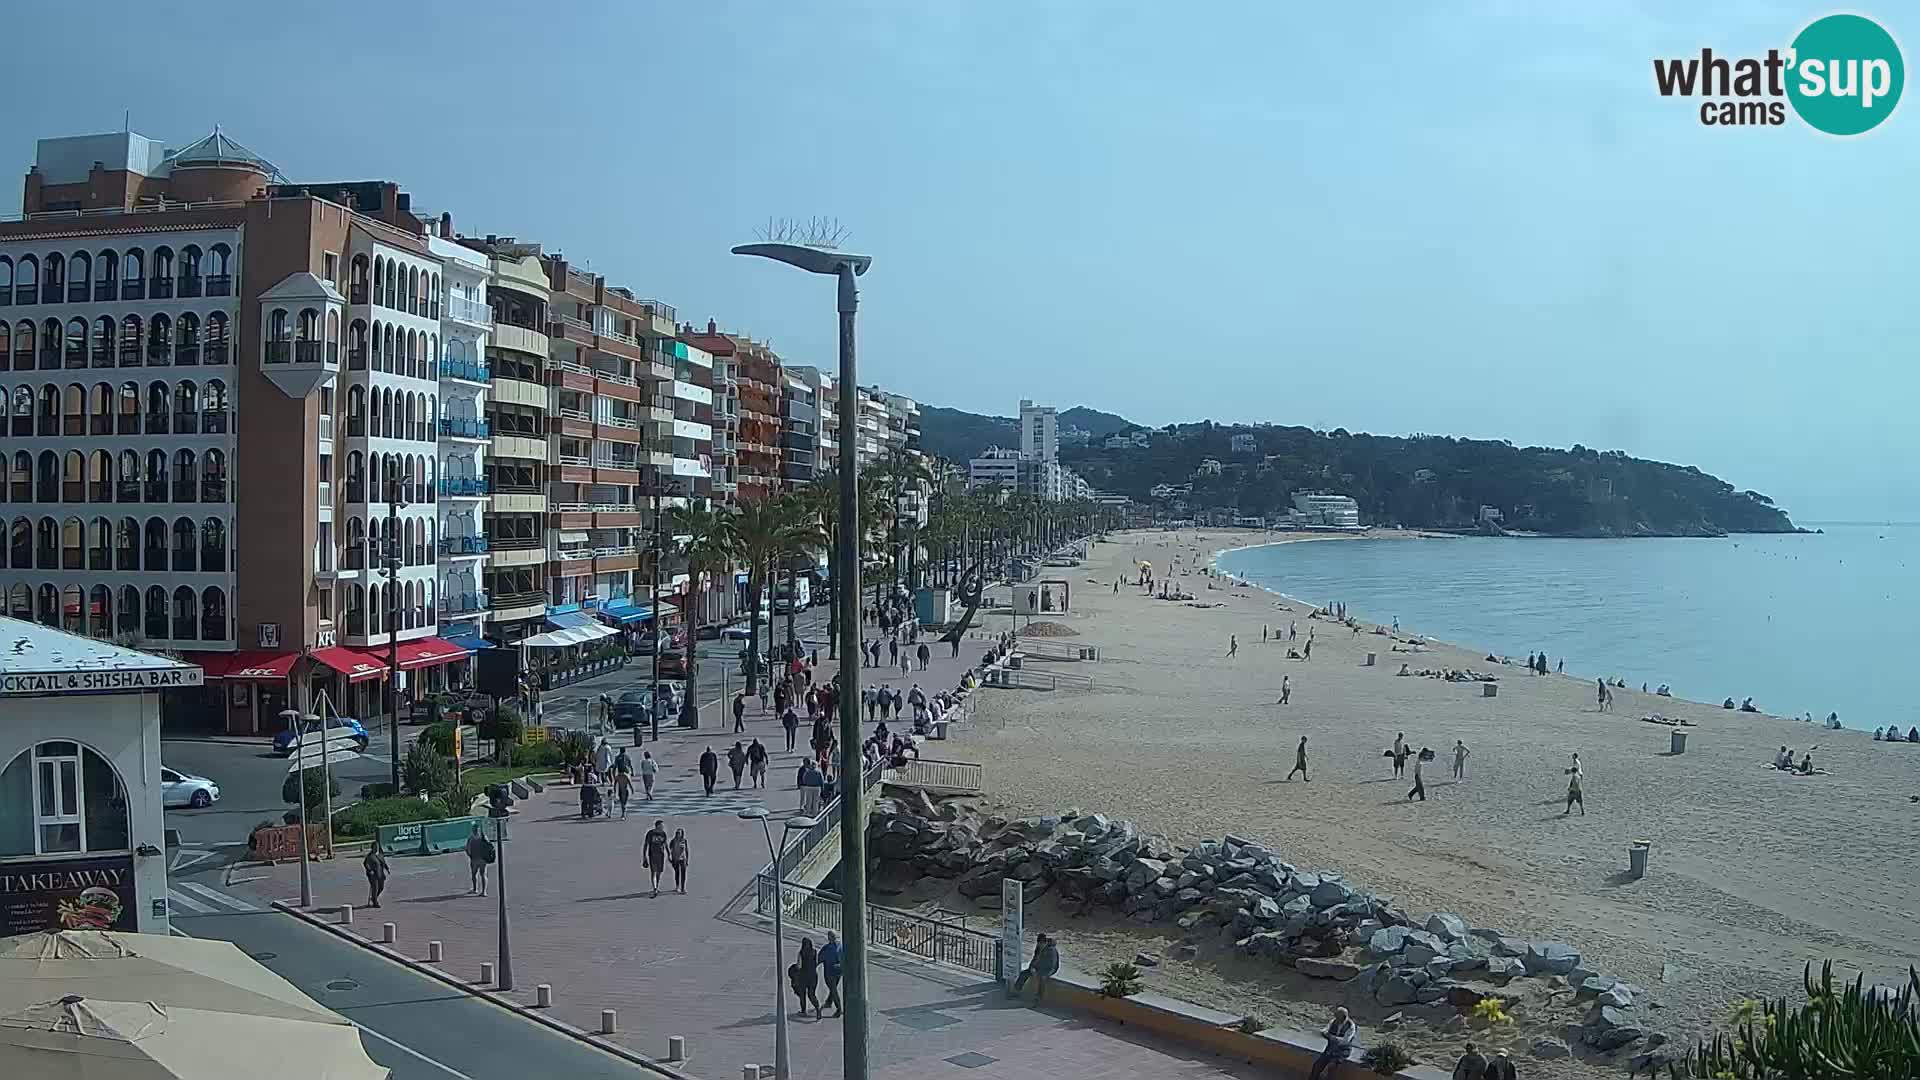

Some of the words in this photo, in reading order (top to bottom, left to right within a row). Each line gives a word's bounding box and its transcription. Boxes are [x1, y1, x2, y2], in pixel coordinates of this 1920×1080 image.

[318, 630, 336, 647] KFC
[0, 674, 62, 691] CKTAIL
[67, 676, 78, 688] &
[84, 671, 145, 688] SHISHA
[149, 670, 183, 686] BAR
[239, 667, 277, 676] KFC
[3, 867, 126, 893] TAKEAWAY
